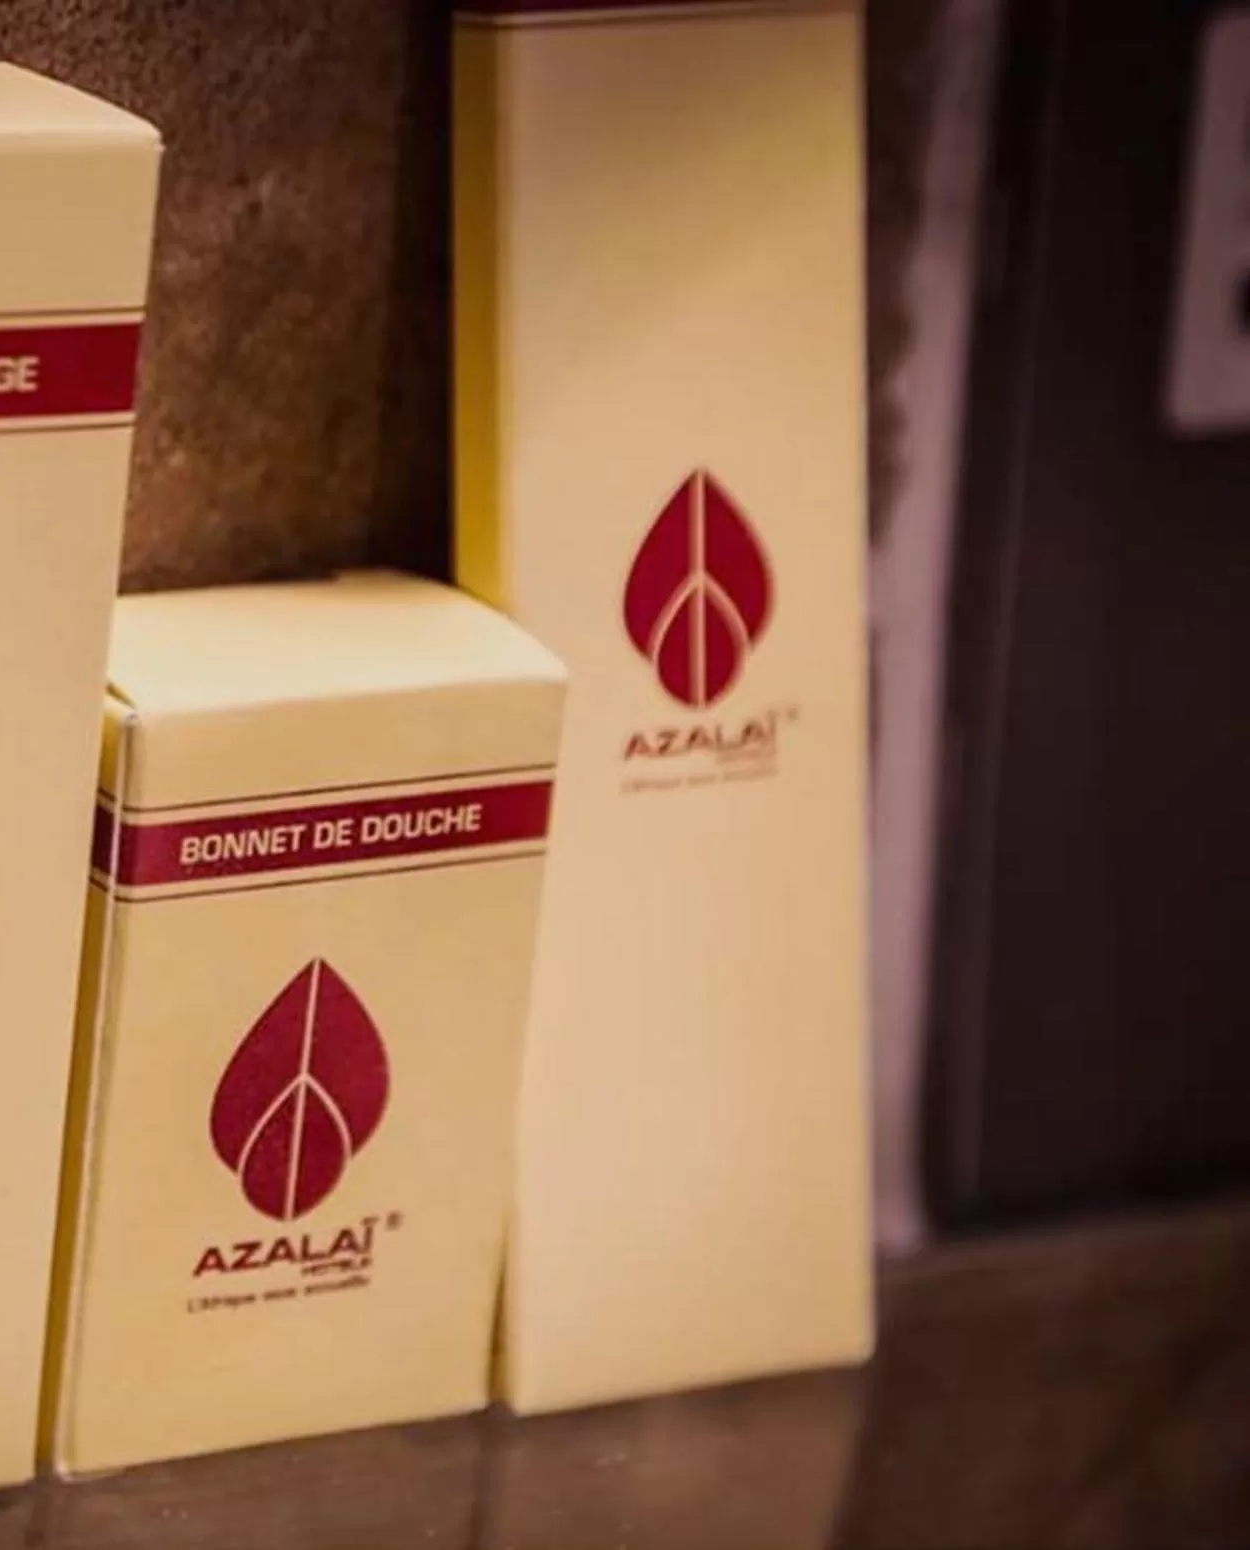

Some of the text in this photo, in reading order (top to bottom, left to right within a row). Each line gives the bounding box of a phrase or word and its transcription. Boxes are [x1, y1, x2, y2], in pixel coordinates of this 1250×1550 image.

[179, 803, 483, 865] BONNET DE DOUCHE
